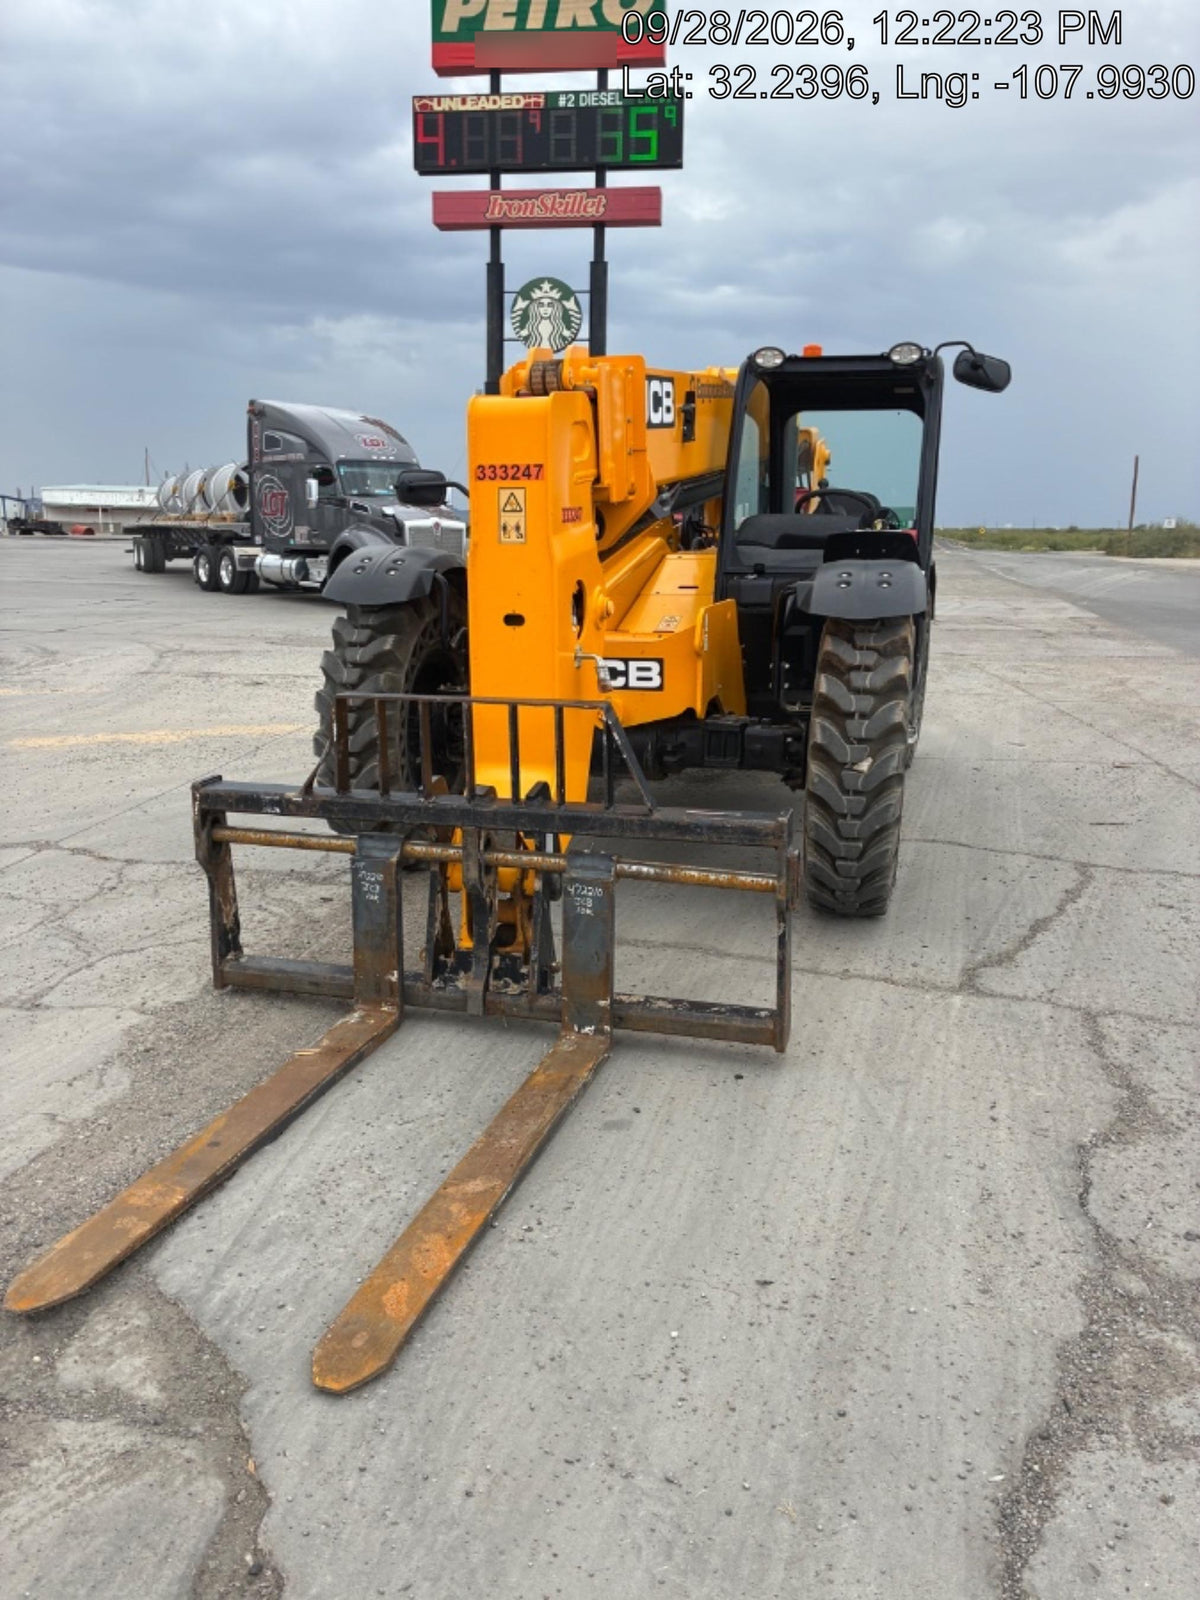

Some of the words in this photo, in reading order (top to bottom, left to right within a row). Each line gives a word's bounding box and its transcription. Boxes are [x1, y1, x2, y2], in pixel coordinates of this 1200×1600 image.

[433, 95, 525, 110] UNLEADED
[558, 93, 575, 107] #2
[578, 92, 623, 106] DIESEL
[645, 379, 675, 424] CB
[476, 464, 543, 480] 333247
[604, 660, 663, 689] CB
